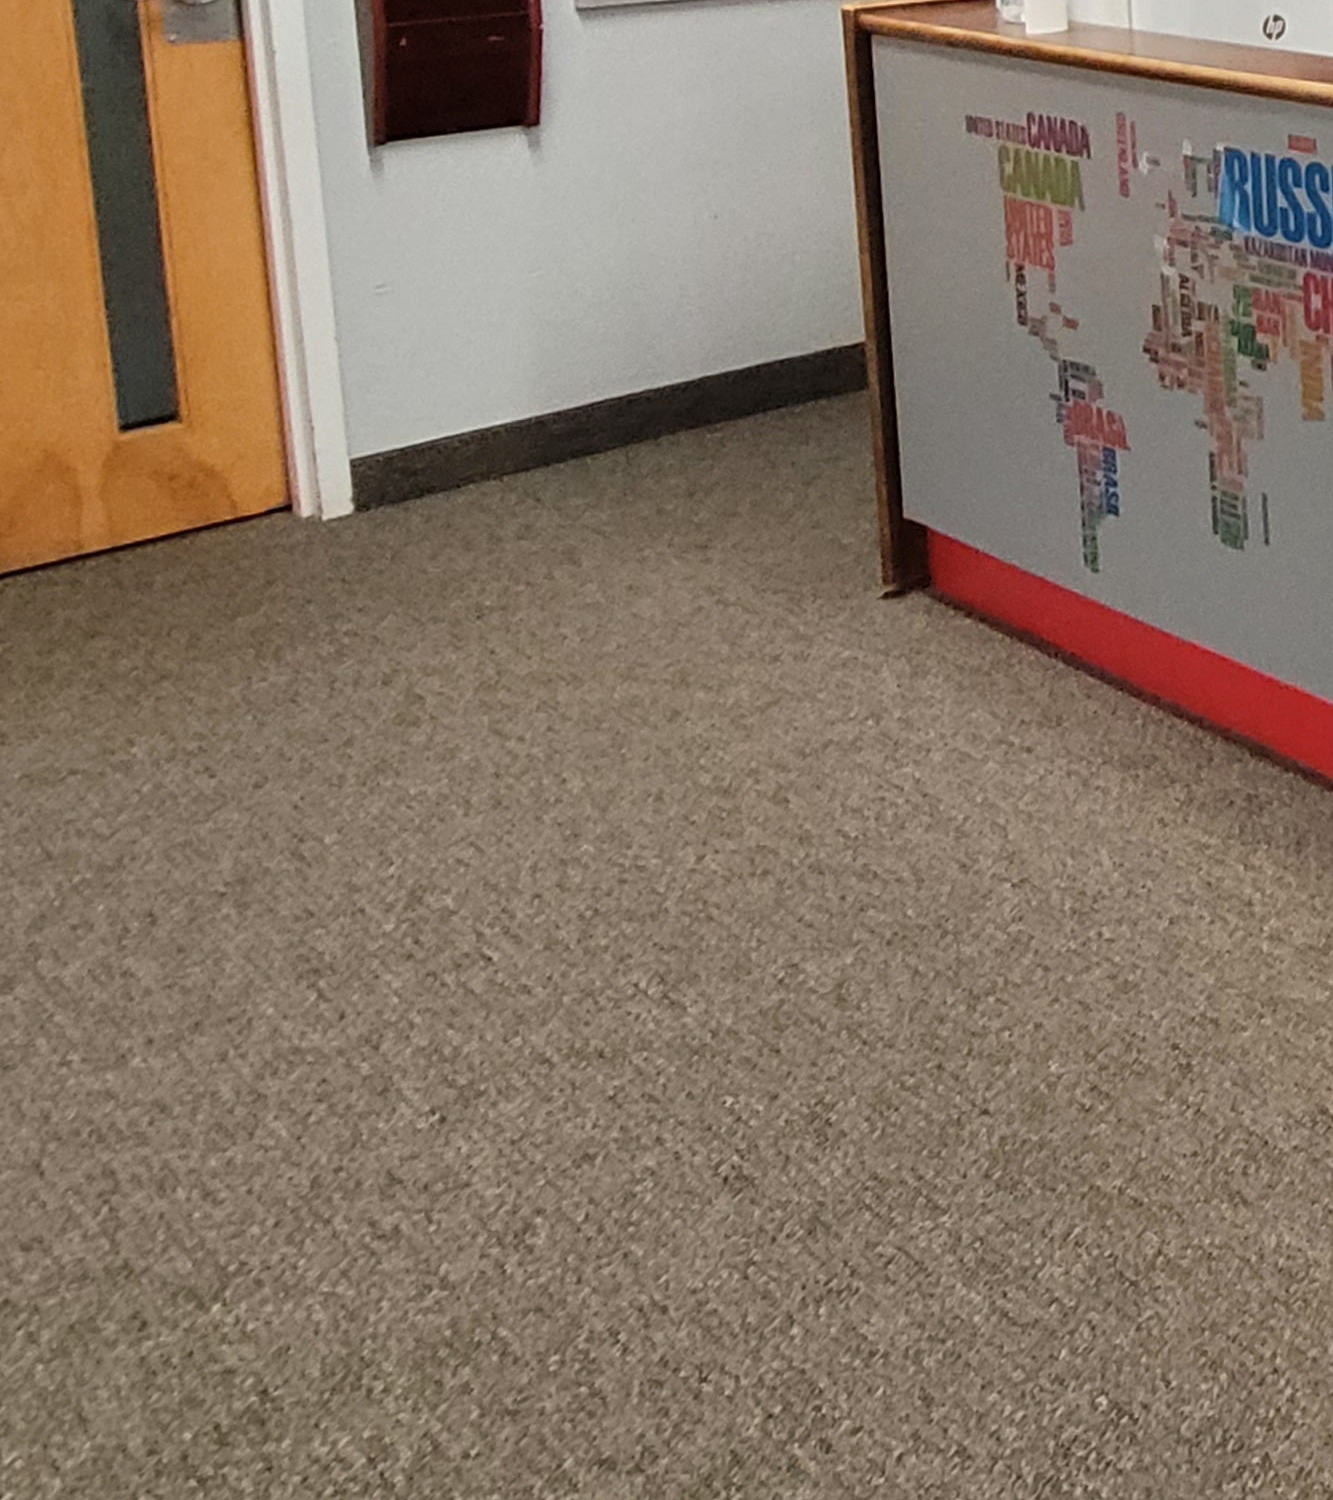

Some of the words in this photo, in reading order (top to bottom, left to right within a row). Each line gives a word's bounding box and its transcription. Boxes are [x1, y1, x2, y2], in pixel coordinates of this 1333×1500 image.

[1263, 14, 1286, 41] hp
[1026, 111, 1091, 160] CANADA
[998, 144, 1085, 212] CANADA
